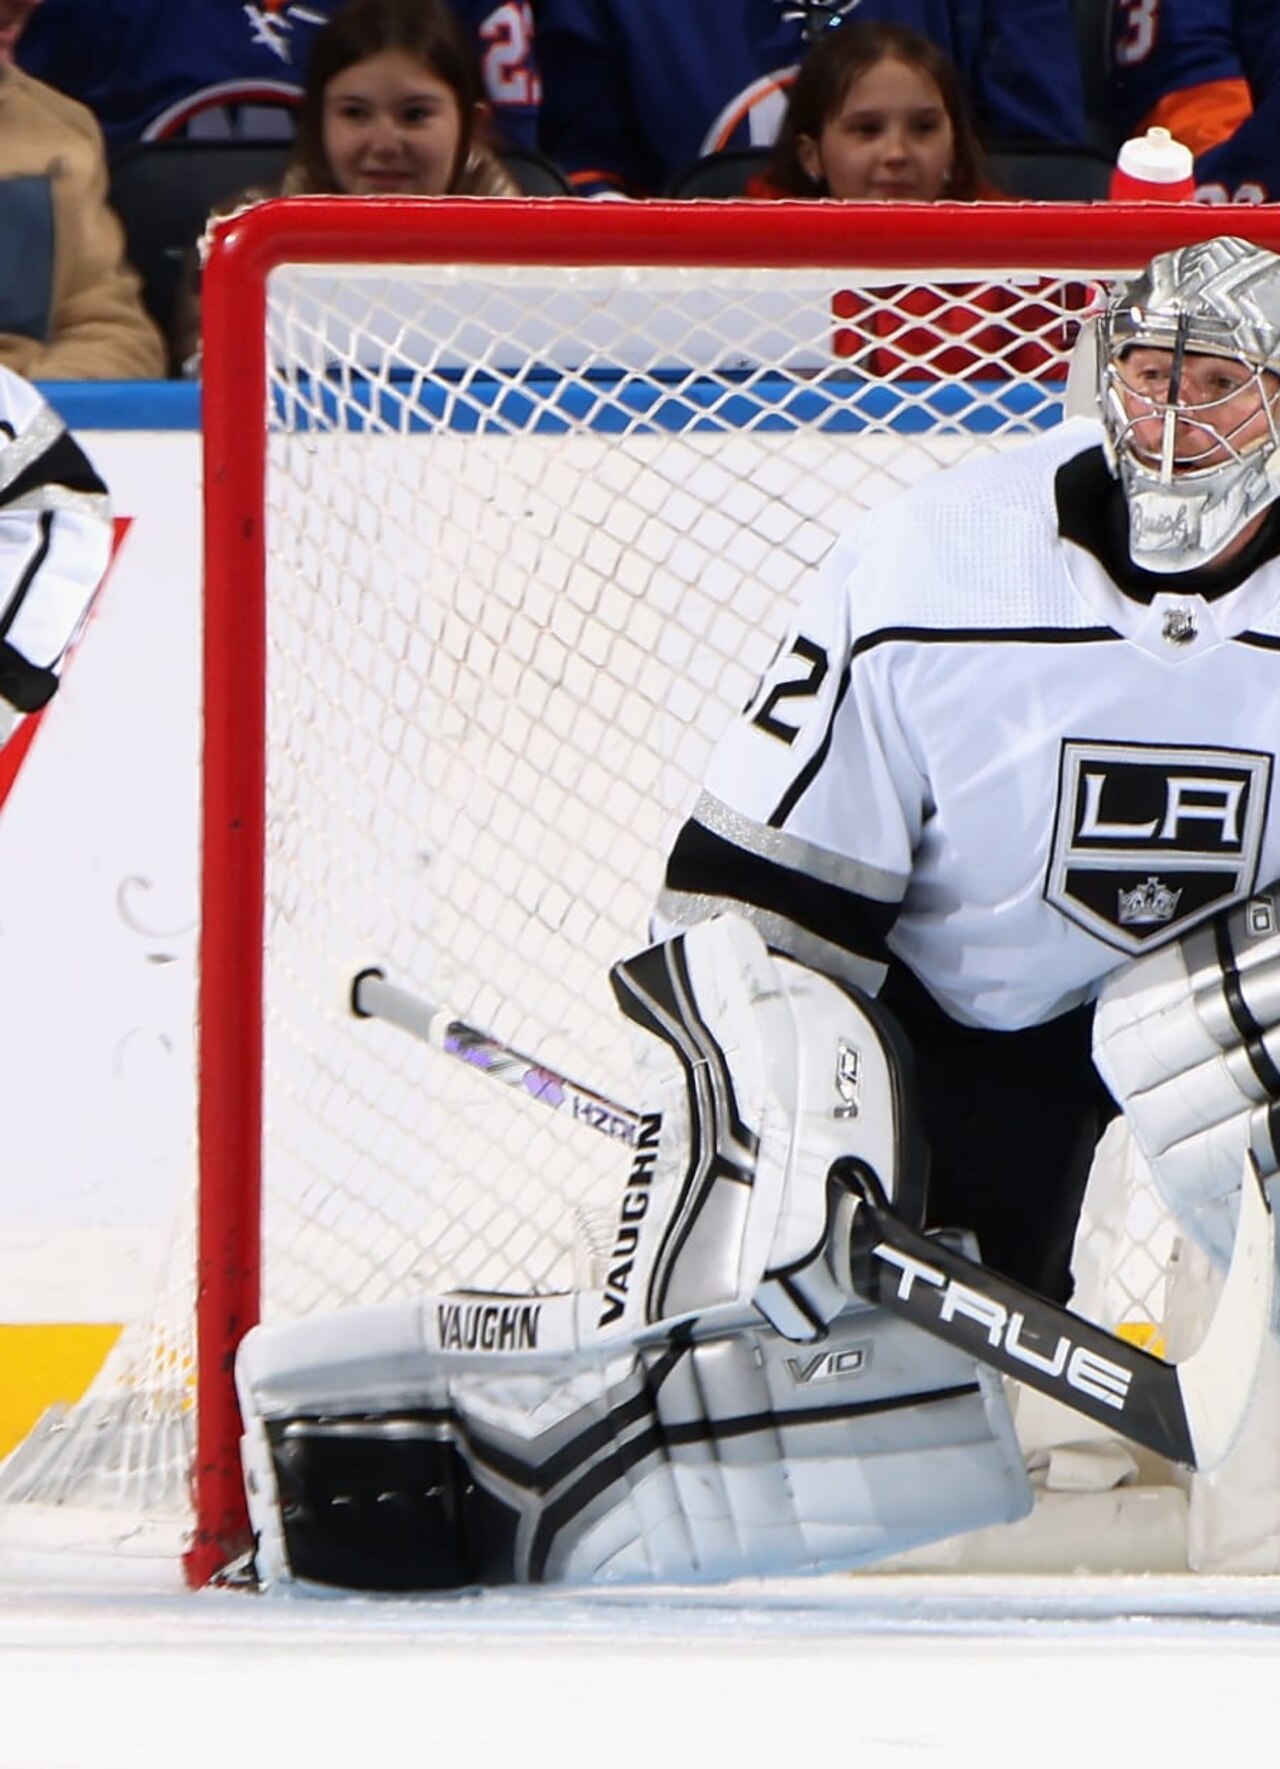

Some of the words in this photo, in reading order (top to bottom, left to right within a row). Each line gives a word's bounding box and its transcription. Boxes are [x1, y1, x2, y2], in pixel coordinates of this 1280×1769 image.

[1078, 773, 1246, 843] LA
[598, 1112, 663, 1329] VAUGHN
[438, 1304, 542, 1350] VAUGHN
[872, 1242, 1133, 1410] TRUE
